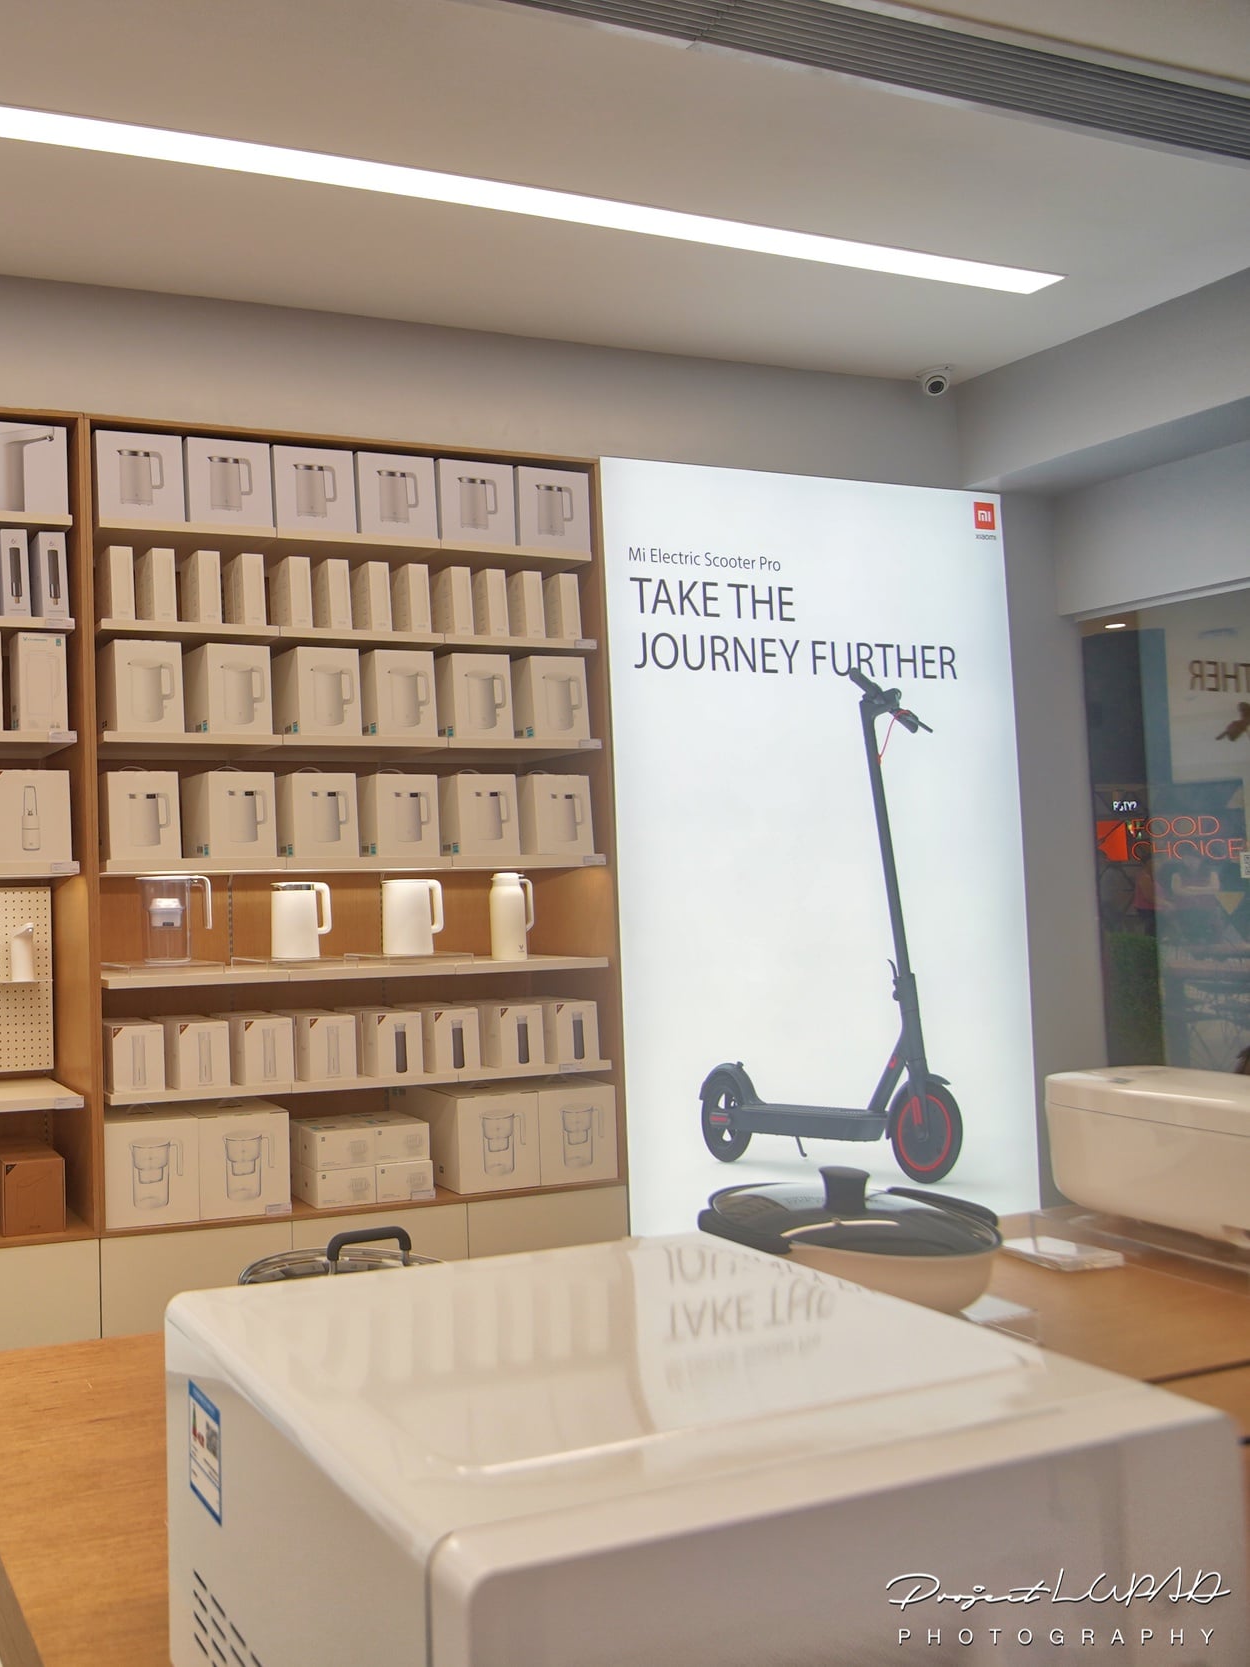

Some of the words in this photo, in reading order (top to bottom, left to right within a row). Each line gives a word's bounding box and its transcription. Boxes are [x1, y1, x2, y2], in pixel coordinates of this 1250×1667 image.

[628, 546, 646, 563] Mi
[650, 548, 701, 567] Electric
[704, 552, 756, 571] Scooter
[760, 557, 781, 573] Pro
[630, 576, 721, 618] TAKE
[727, 583, 796, 622] THE
[634, 632, 800, 674] JOURNEY
[811, 640, 958, 681] FURTHER
[1131, 815, 1220, 838] FOOD
